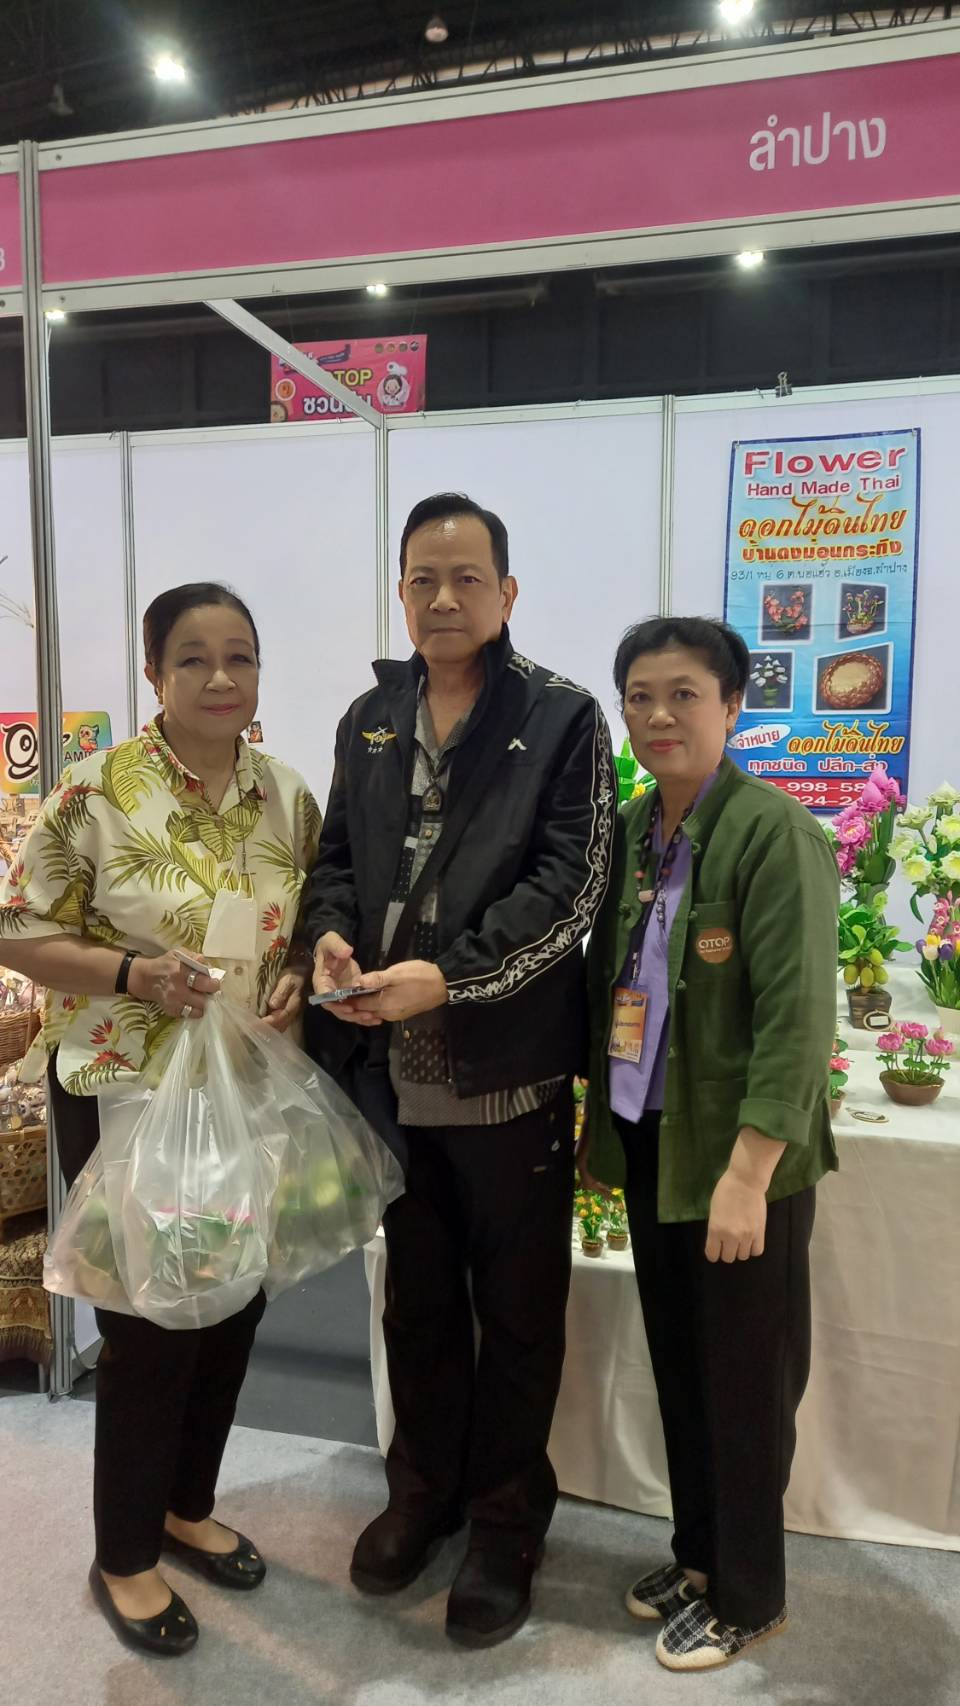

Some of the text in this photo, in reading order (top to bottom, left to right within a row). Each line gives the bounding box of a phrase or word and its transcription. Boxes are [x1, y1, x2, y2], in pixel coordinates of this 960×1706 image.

[749, 112, 887, 171] ลำปาง
[330, 368, 372, 386] TOP
[744, 447, 906, 476] Flower
[748, 475, 900, 496] Hand Made Thai
[739, 495, 907, 538] ดอกไม้ดินไทย
[730, 569, 753, 581] 93/1
[777, 569, 784, 579] 6
[737, 726, 780, 748] จำหน่าย
[788, 720, 904, 755] ดอกไม้ดินไทย
[749, 759, 806, 775] ทุกชนิด
[768, 781, 866, 792] -998-58
[698, 936, 730, 949] OTOP
